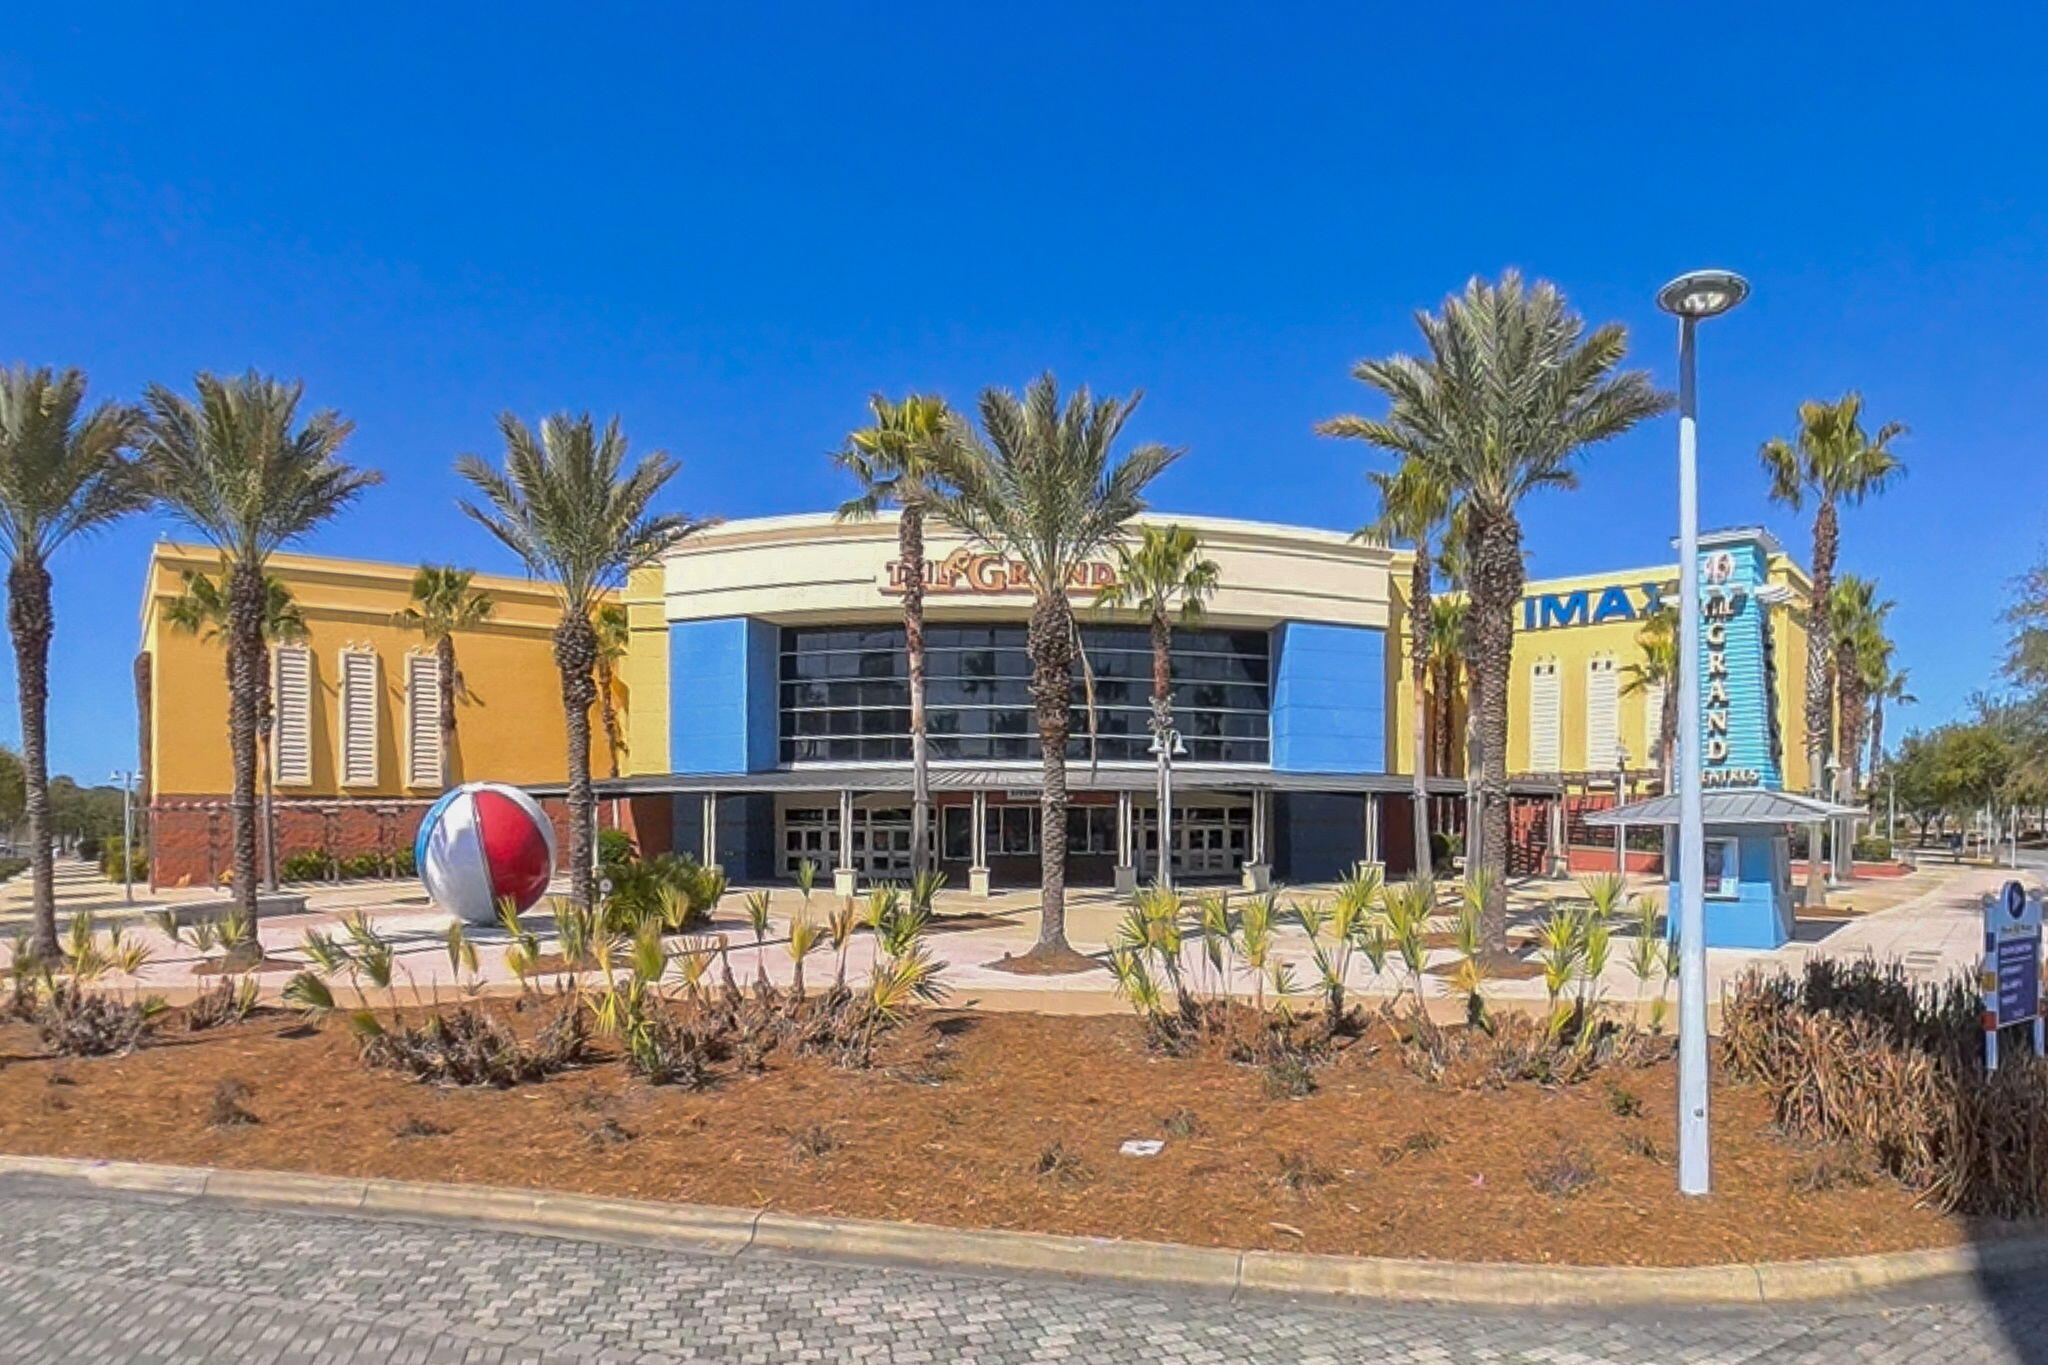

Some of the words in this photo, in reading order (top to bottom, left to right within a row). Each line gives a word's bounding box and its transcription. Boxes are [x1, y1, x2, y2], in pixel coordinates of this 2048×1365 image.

[967, 552, 1117, 592] GRND
[1524, 582, 1661, 631] IMAX
[1707, 624, 1728, 760] GRAND
